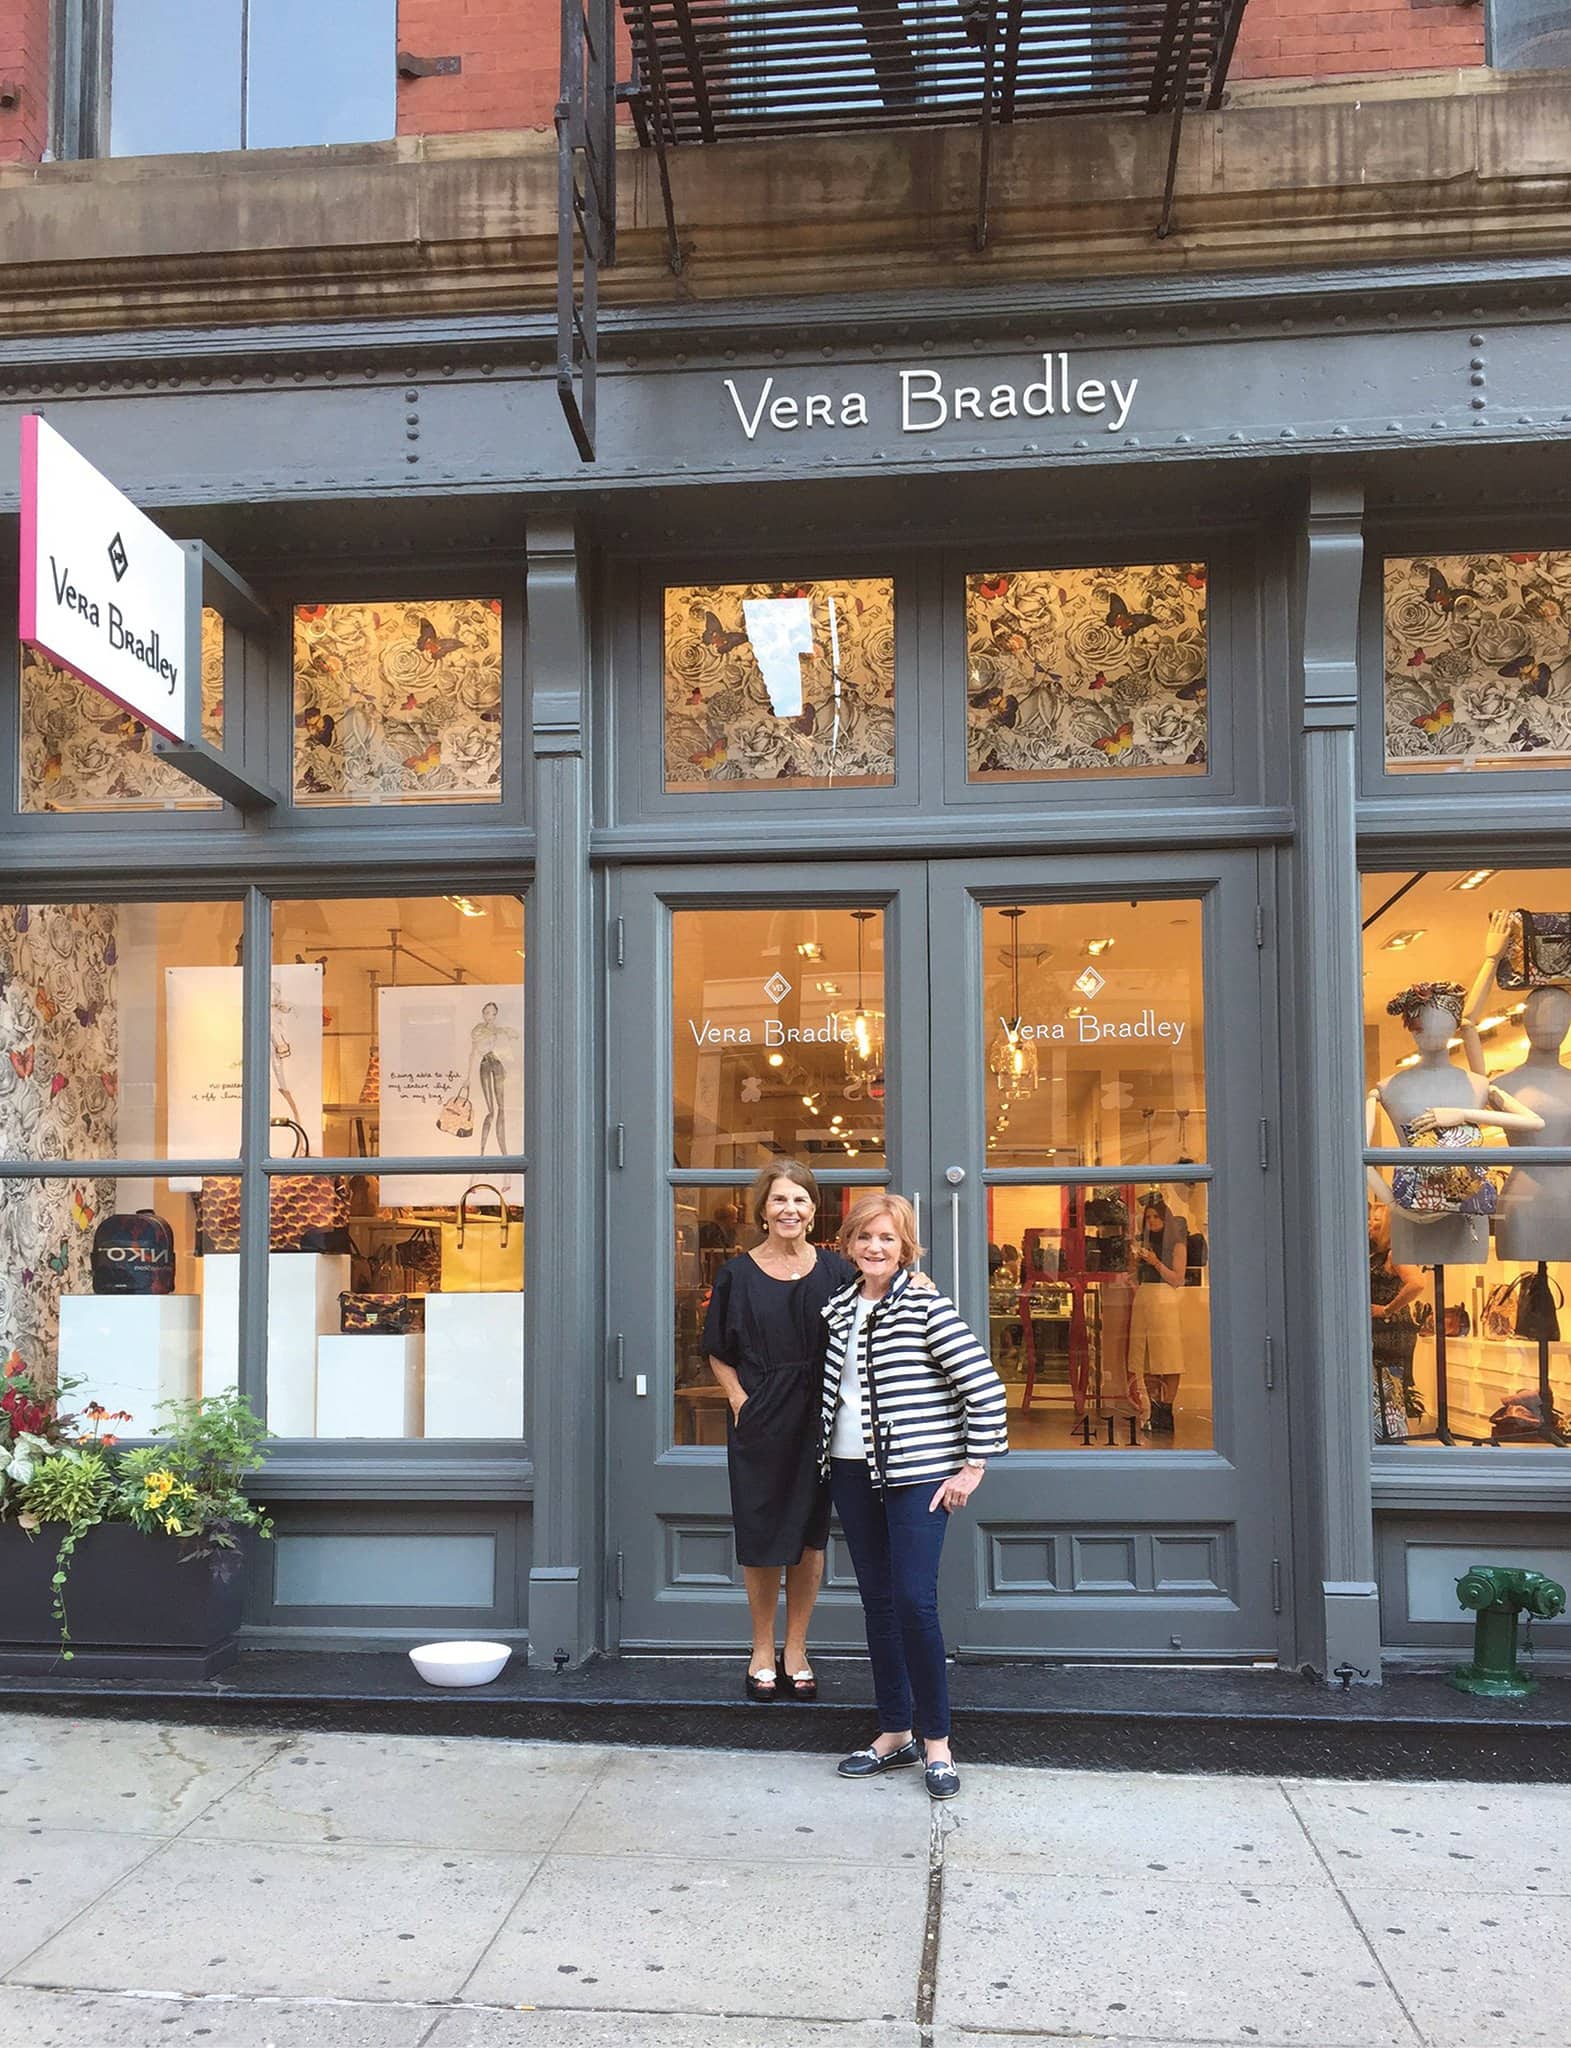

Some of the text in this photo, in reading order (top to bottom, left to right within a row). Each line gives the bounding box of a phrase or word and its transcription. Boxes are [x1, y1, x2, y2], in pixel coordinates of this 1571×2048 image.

[723, 352, 1139, 440] Vera Bradley
[49, 555, 177, 696] Vera Bradley
[688, 1019, 752, 1047] Vera
[1000, 1009, 1186, 1045] Vera Bradley
[1070, 1415, 1141, 1446] 411
